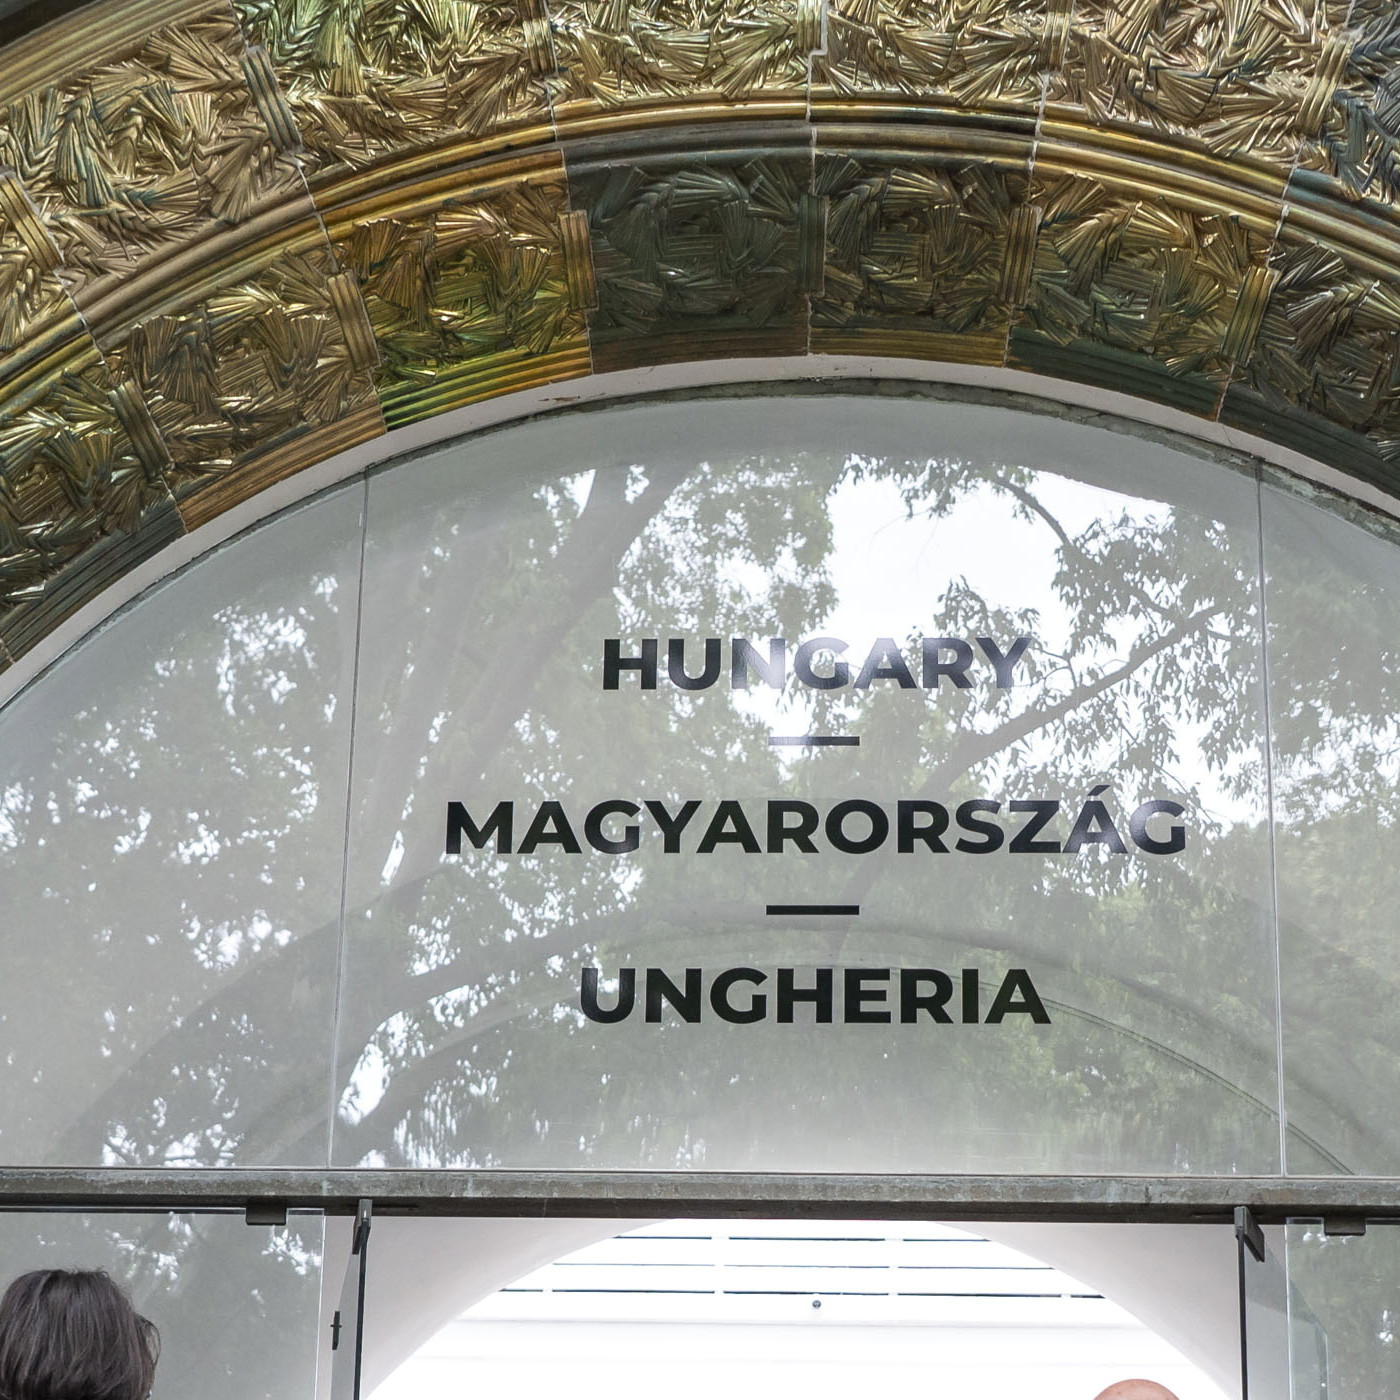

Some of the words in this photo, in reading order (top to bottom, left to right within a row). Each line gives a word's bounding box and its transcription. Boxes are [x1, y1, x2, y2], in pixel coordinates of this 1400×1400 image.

[602, 638, 1033, 690] HUNGARY
[445, 785, 1188, 855] MAGYARORSZÁG
[580, 967, 1052, 1025] UNGHERIA
